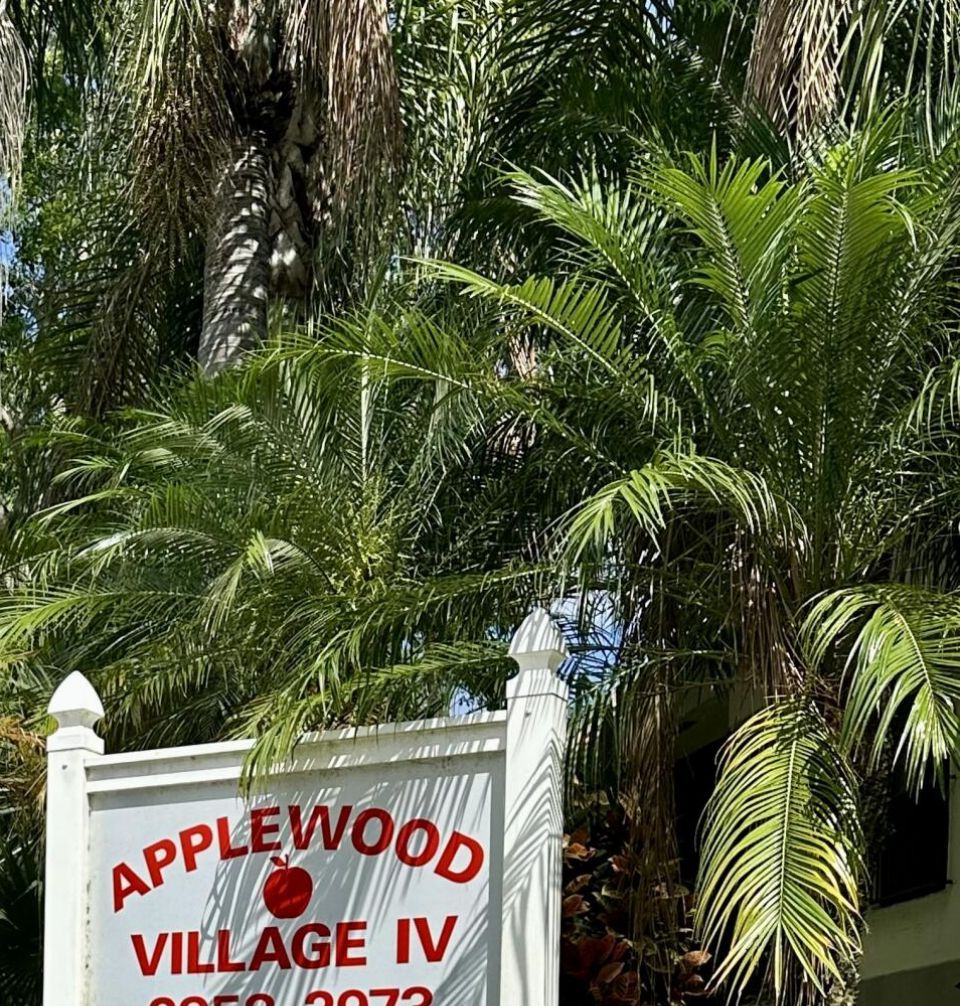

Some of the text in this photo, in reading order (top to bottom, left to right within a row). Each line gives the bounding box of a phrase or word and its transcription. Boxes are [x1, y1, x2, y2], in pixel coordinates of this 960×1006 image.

[111, 805, 485, 912] APPLEWOOD
[130, 915, 459, 976] VILLAGE IV
